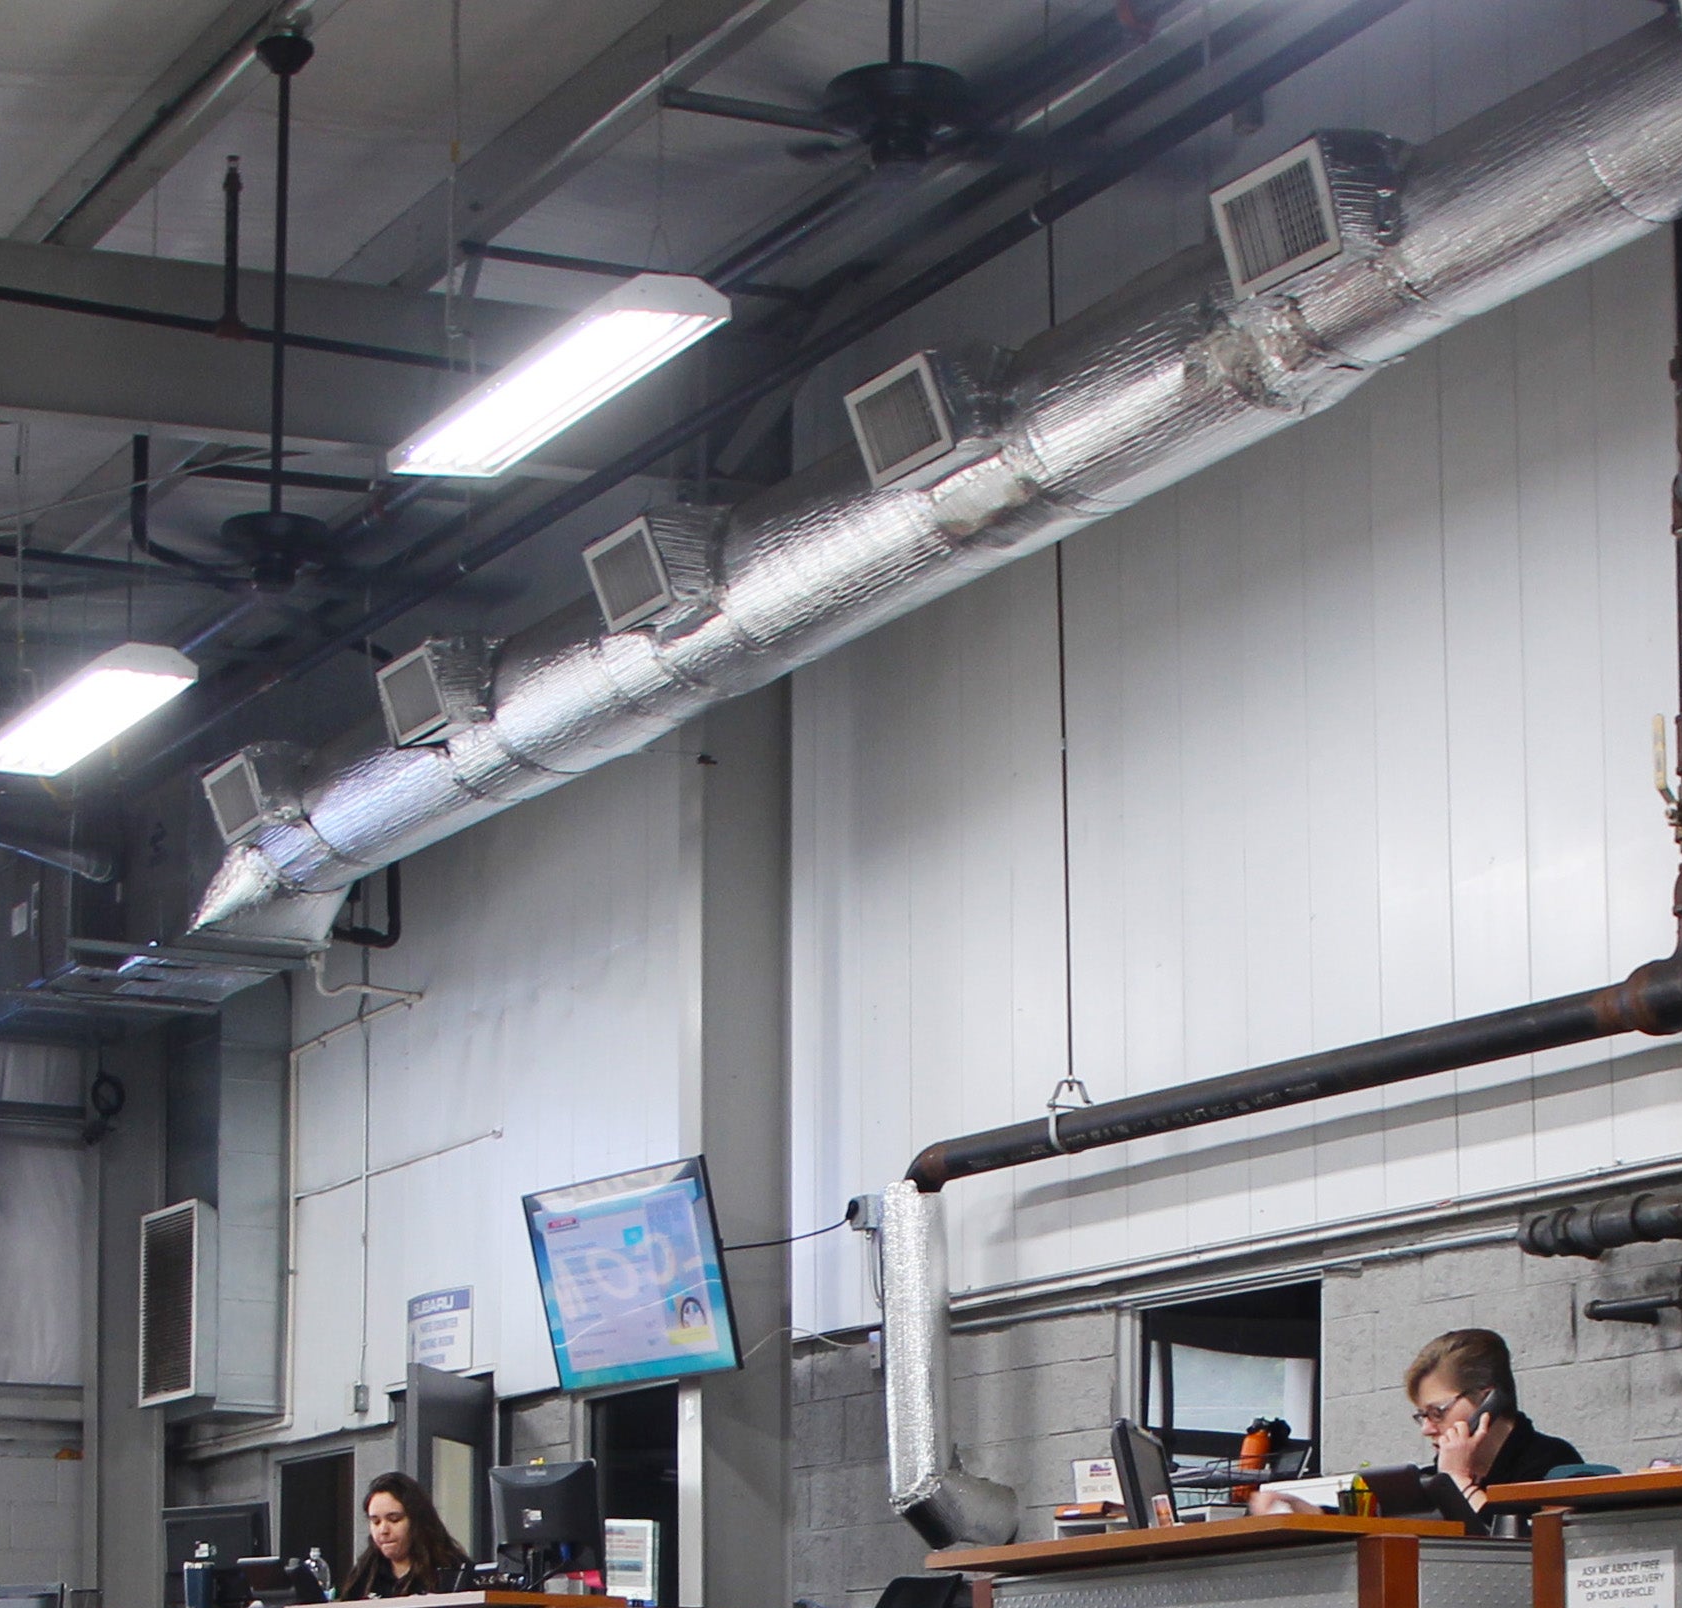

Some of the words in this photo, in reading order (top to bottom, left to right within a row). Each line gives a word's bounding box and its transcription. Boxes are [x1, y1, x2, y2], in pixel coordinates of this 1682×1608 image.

[1582, 1566, 1596, 1576] ASK
[1599, 1564, 1610, 1574] ME
[1612, 1561, 1639, 1573] ABOUT
[1640, 1559, 1660, 1570] FREE
[1577, 1577, 1608, 1588] PICK-UP
[1610, 1576, 1626, 1585] AND
[1628, 1572, 1664, 1585] DELIVERY
[1586, 1591, 1596, 1601] OF
[1598, 1589, 1620, 1600] YOUR
